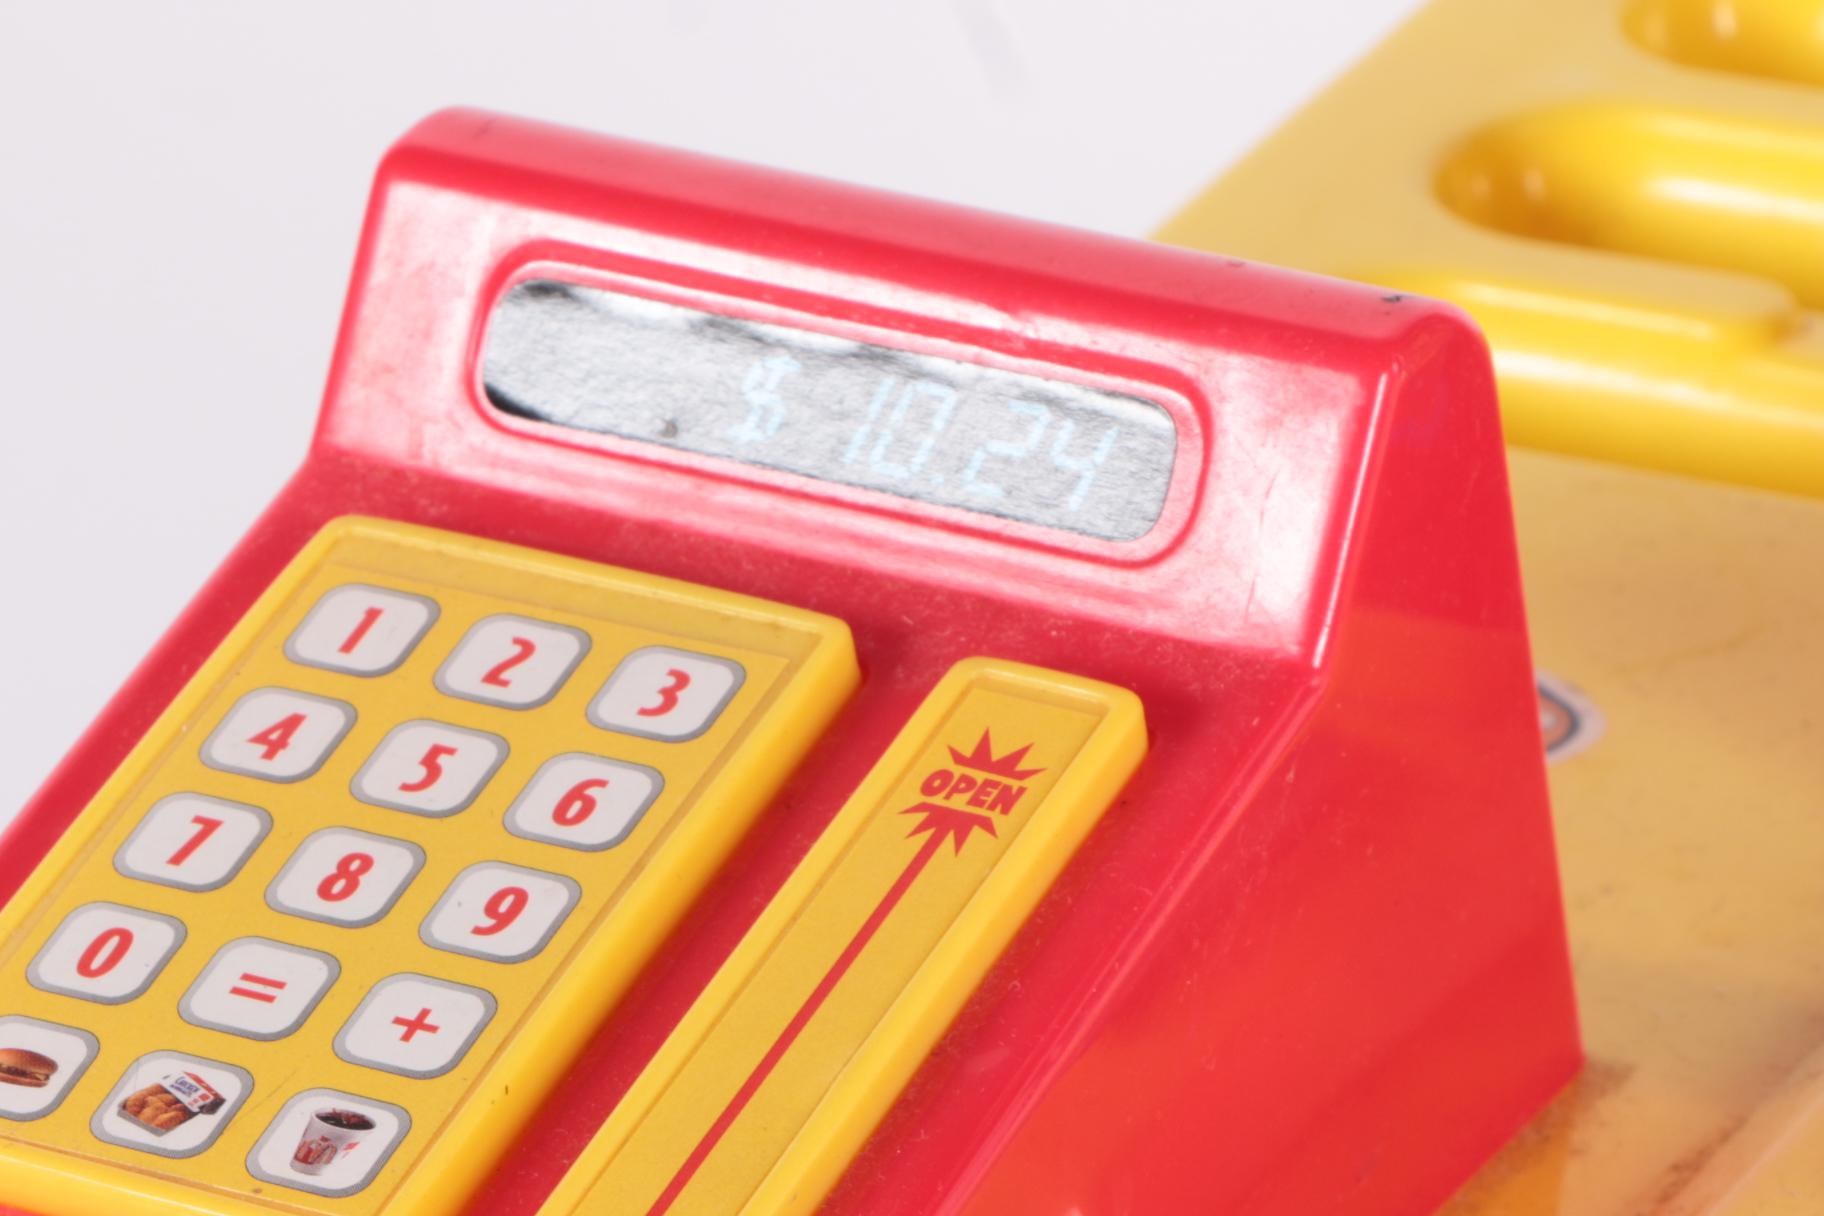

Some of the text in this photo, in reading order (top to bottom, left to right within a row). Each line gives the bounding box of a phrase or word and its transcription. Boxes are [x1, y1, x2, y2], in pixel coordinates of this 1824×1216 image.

[726, 353, 1121, 512] $ 10.24
[336, 606, 692, 718] 1 2 3
[246, 712, 610, 827] 4 5 6
[919, 768, 1029, 817] OPEN
[165, 814, 530, 937] 7 8 9
[75, 926, 440, 1043] 0 = +
